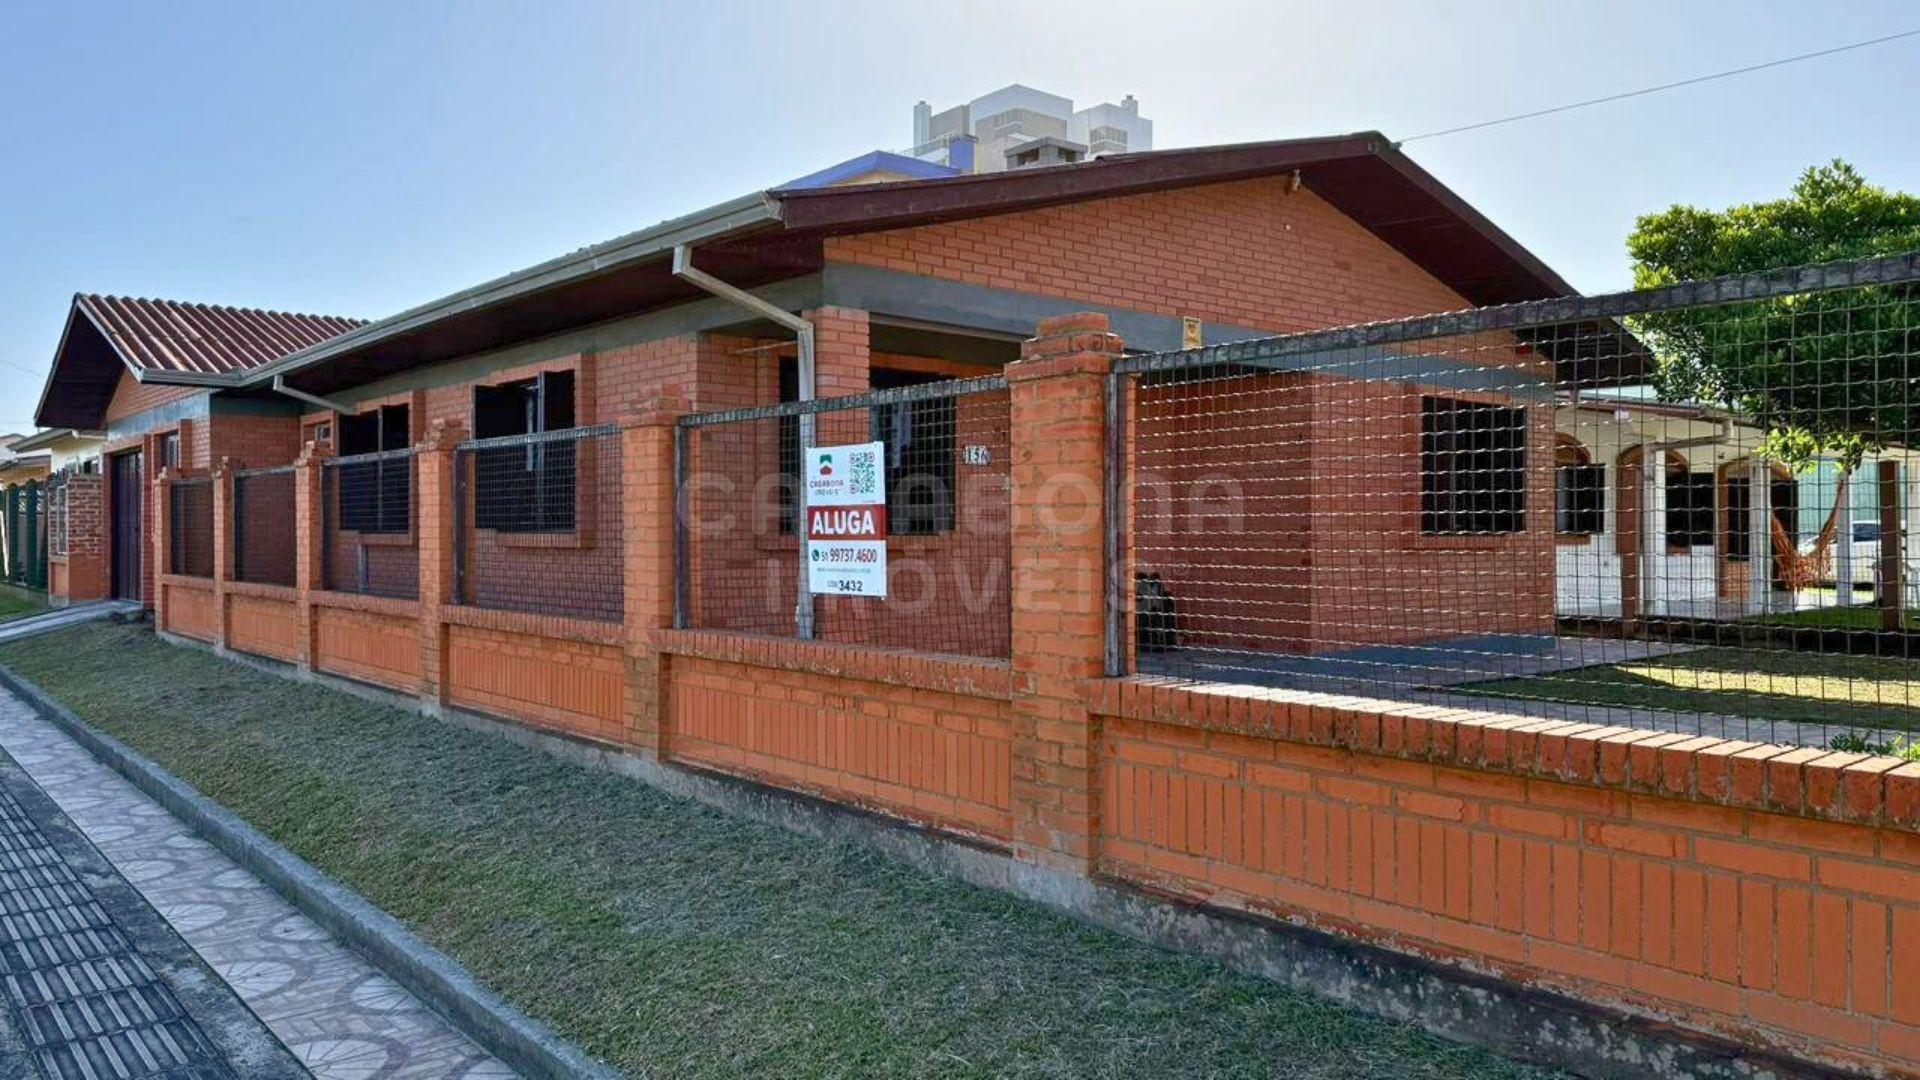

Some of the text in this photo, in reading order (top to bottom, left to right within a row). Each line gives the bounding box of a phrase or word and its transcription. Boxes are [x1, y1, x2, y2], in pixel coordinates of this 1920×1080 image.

[812, 510, 875, 535] ALUGA
[830, 548, 877, 563] 99737.4600
[839, 579, 863, 592] 3432
